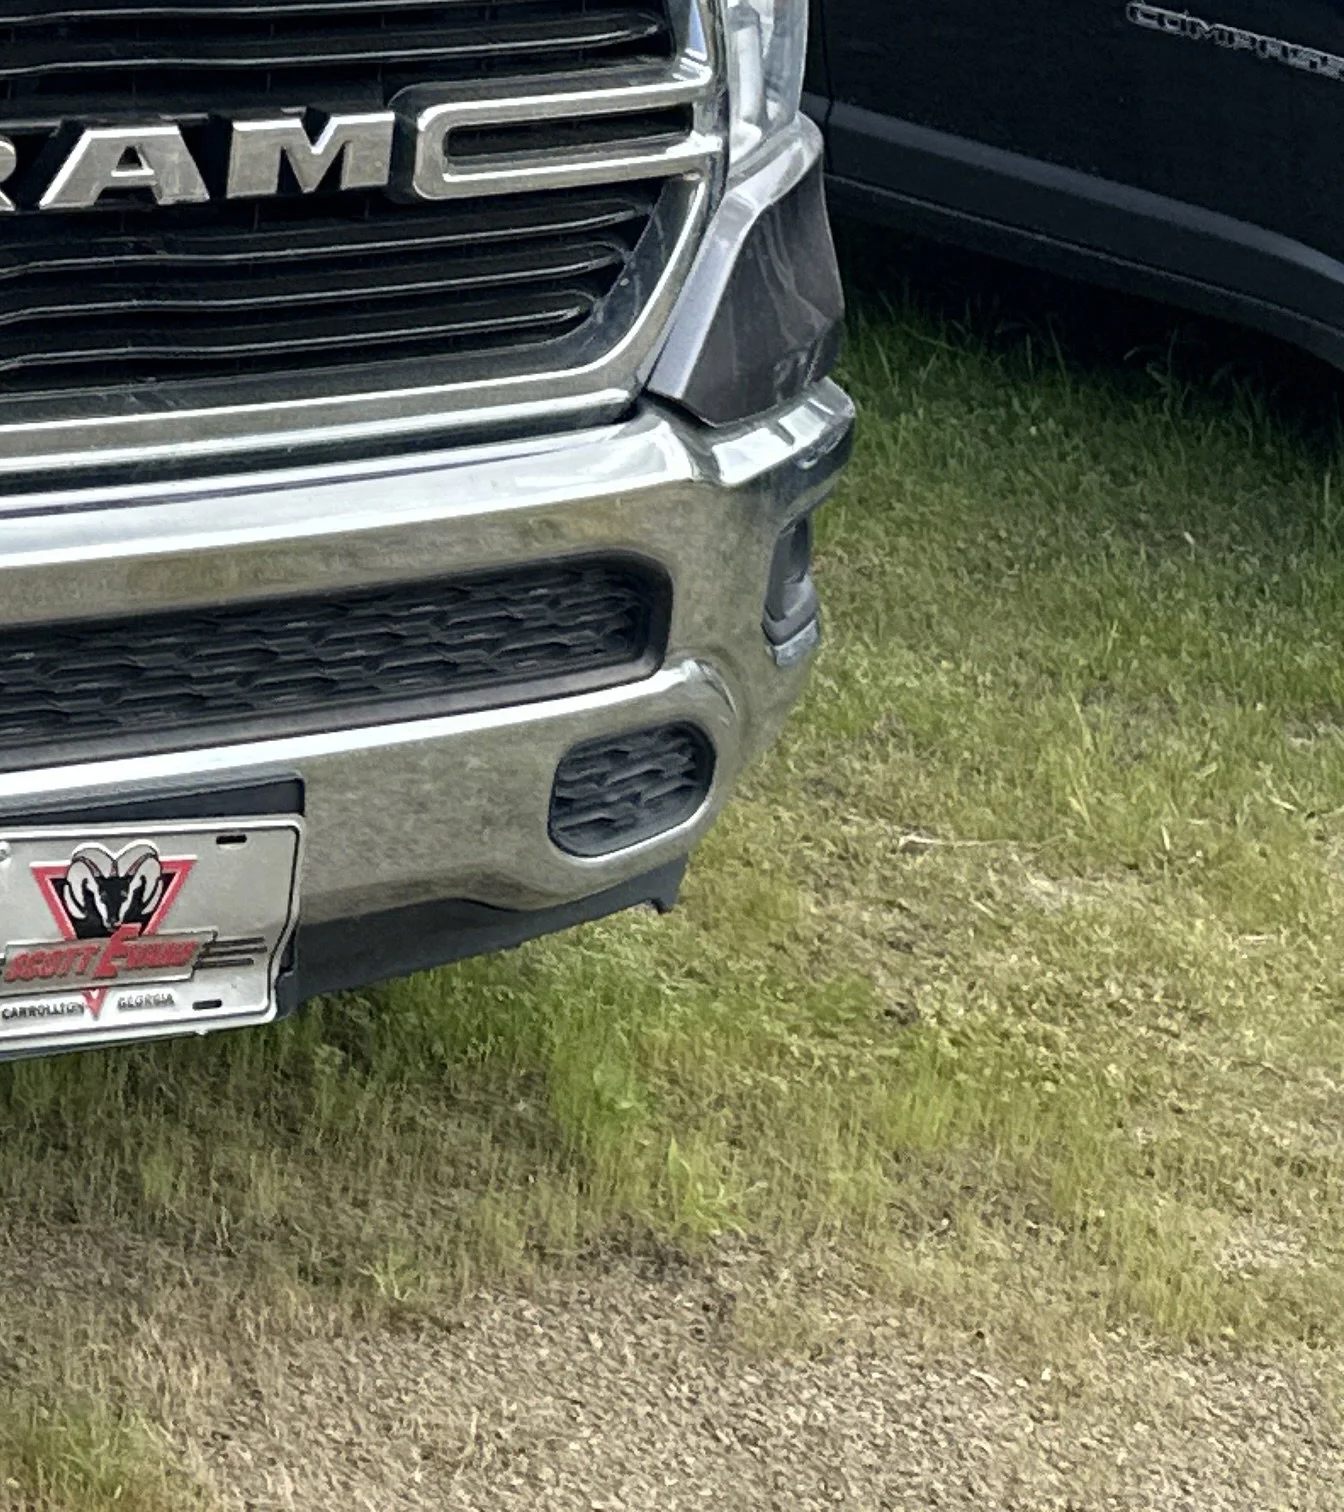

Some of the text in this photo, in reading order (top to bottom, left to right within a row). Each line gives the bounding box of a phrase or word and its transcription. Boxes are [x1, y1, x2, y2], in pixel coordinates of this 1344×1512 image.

[5, 945, 98, 982] SCOTT
[1, 993, 175, 1020] CARROLLTON GEORGIA
